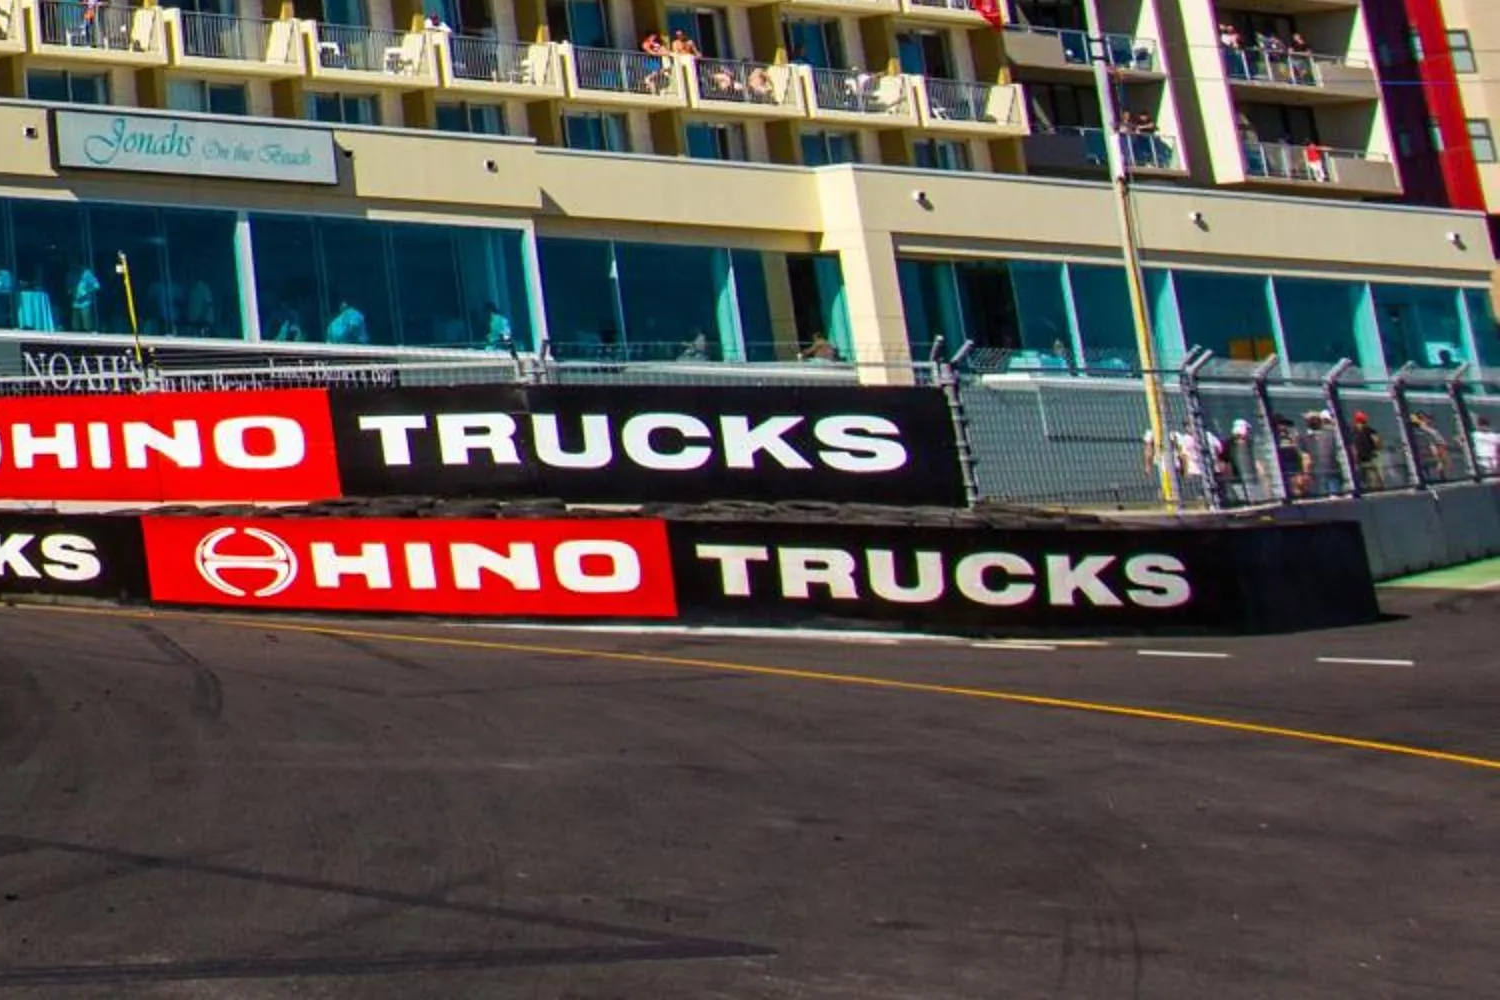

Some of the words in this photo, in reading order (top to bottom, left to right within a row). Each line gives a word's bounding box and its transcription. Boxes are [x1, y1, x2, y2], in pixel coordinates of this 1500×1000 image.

[83, 118, 194, 164] Jonahs
[12, 415, 306, 470] HINO
[358, 412, 908, 473] TRUCKS
[308, 539, 642, 594] HINO
[695, 543, 1192, 609] TRUCKS
